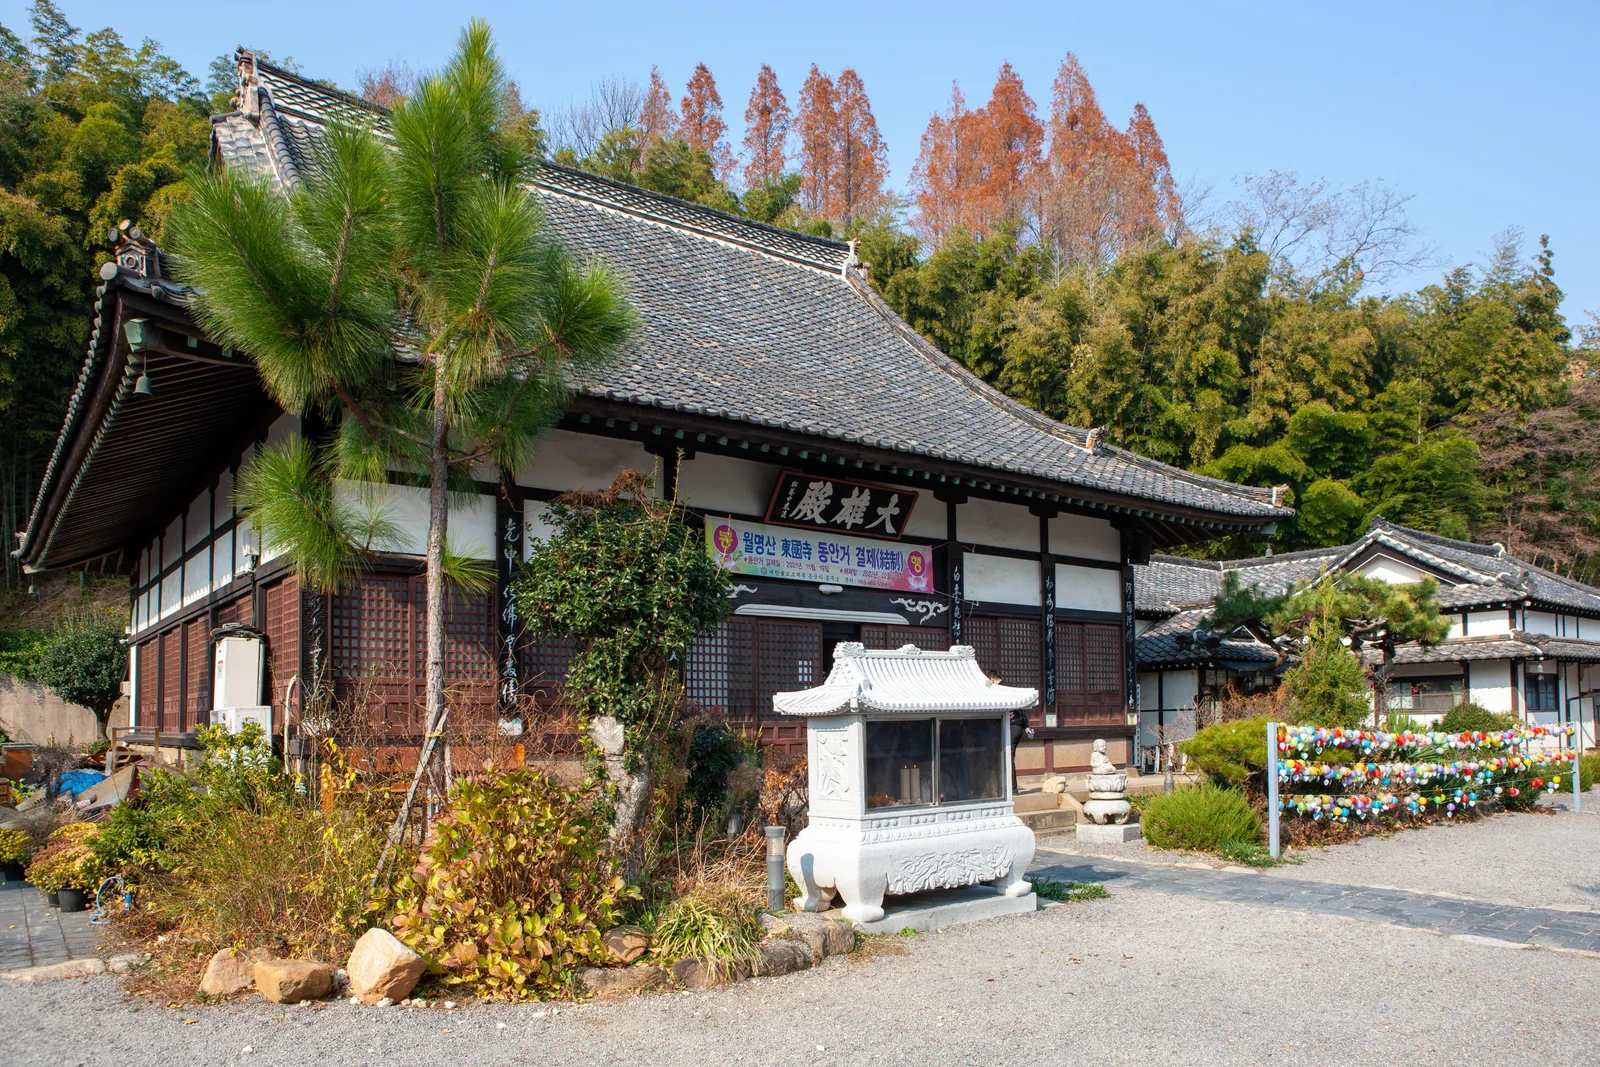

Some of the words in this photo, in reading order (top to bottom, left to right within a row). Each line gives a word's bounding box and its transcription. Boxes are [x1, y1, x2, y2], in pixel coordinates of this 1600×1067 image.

[742, 531, 776, 556] 월명산
[781, 538, 812, 561] 東國寺
[818, 541, 851, 566] 동안거
[855, 546, 904, 572] 결제(結制)
[910, 554, 922, 573] 행
